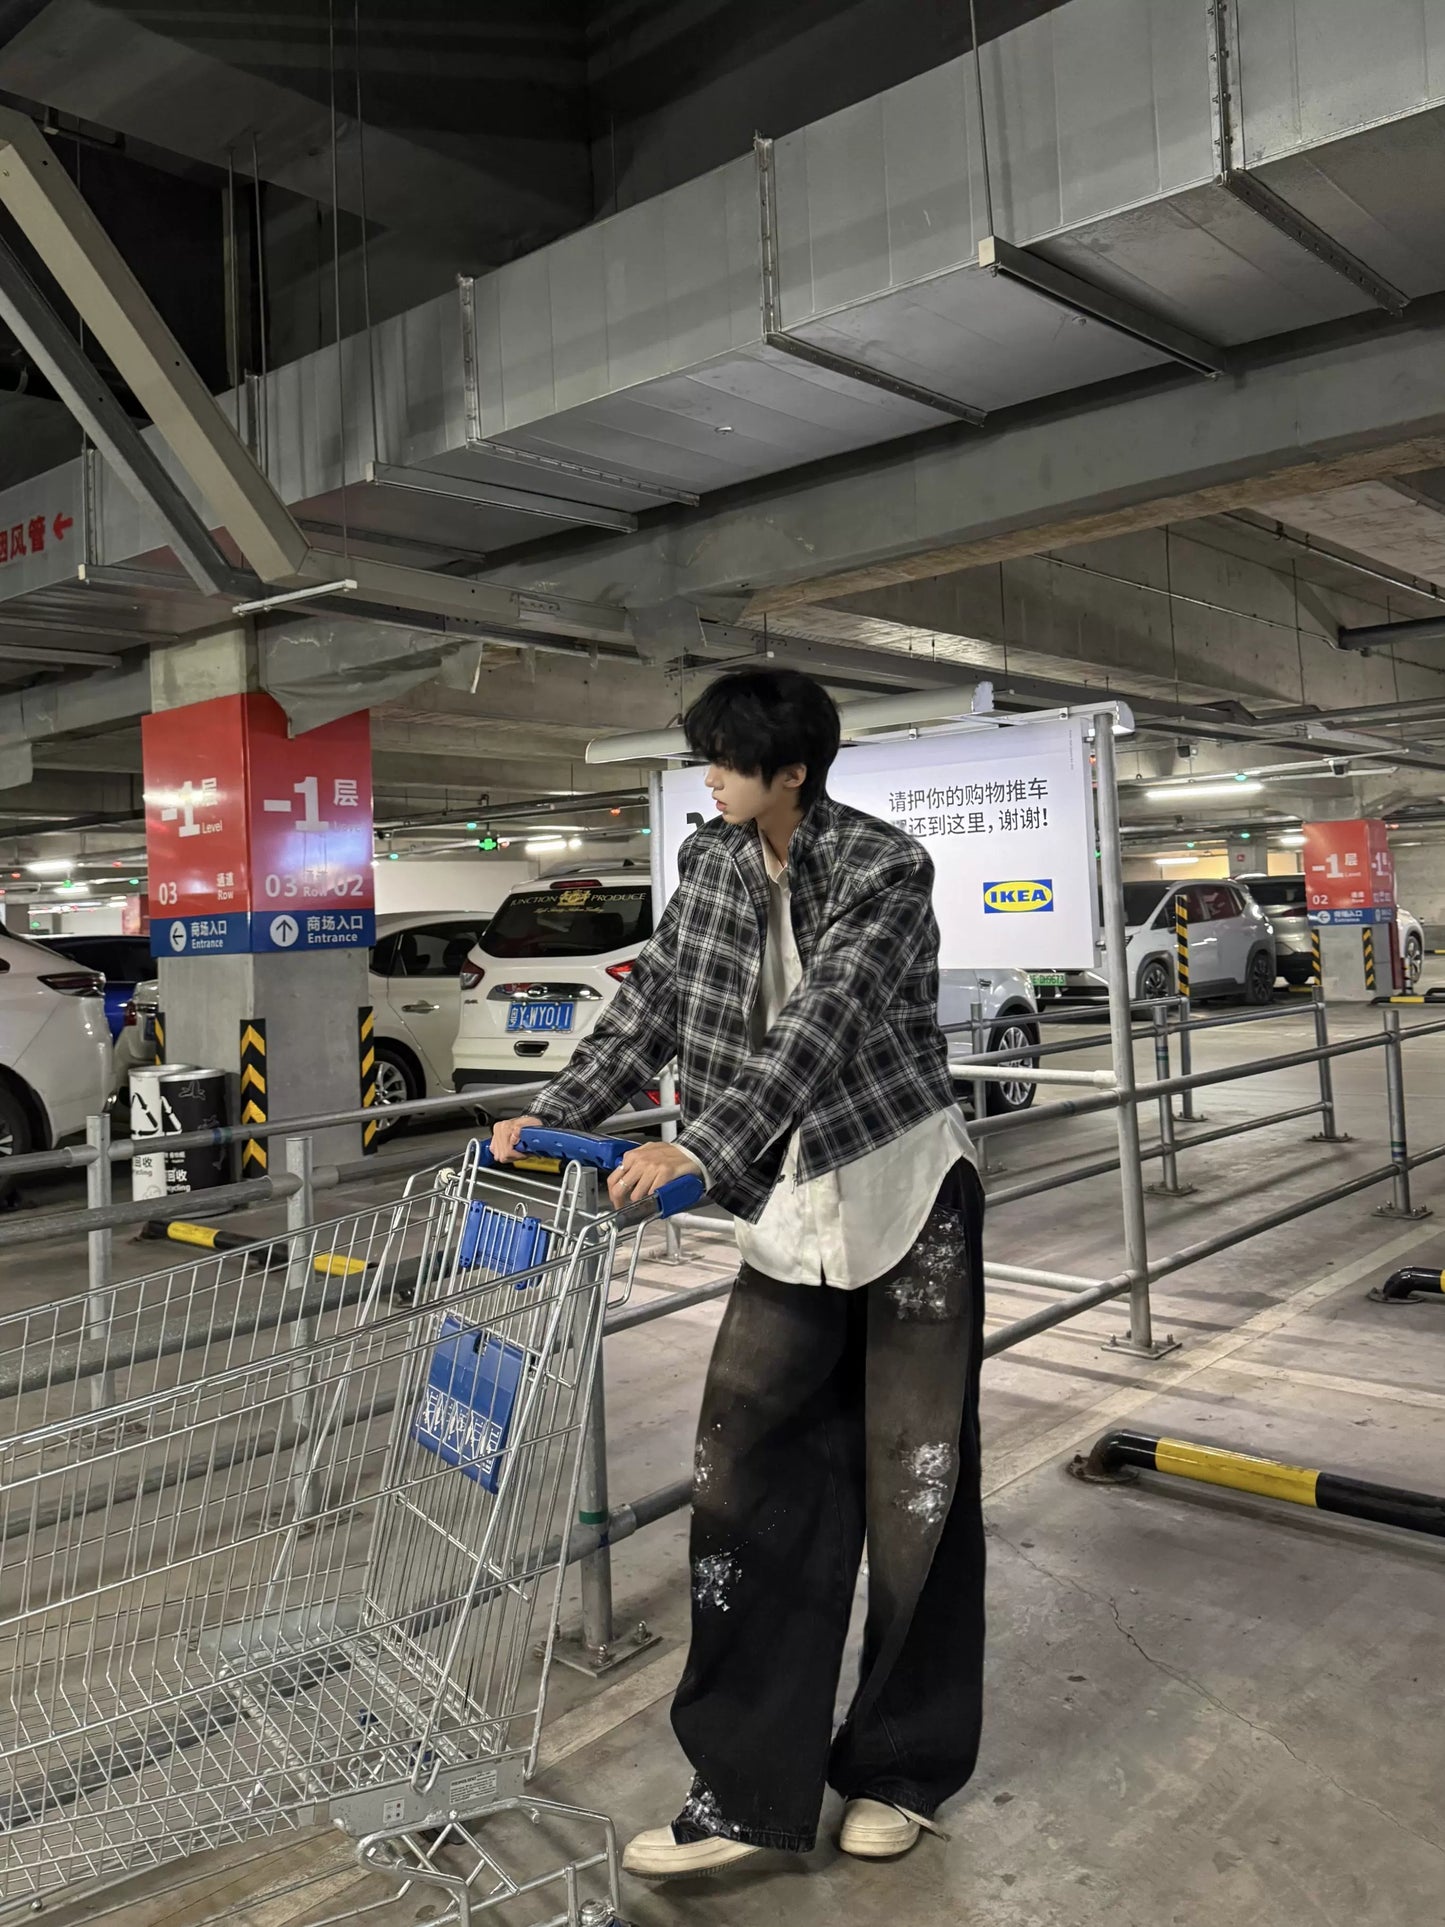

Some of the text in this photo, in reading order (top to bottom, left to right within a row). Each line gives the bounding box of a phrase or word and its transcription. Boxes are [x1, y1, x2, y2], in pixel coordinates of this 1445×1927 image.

[889, 777, 1049, 813] 请把你的购物推车
[202, 820, 222, 834] Level
[265, 874, 298, 898] 03
[333, 874, 364, 896] 02
[158, 882, 177, 905] 03
[217, 889, 234, 901] Row
[590, 892, 647, 902] PRODUCE
[990, 889, 1048, 903] IKEA
[1312, 895, 1328, 905] 02
[191, 920, 227, 937] 商场入口
[307, 915, 363, 931] 商场入口
[192, 939, 224, 949] Entrance
[307, 932, 358, 944] Entrance
